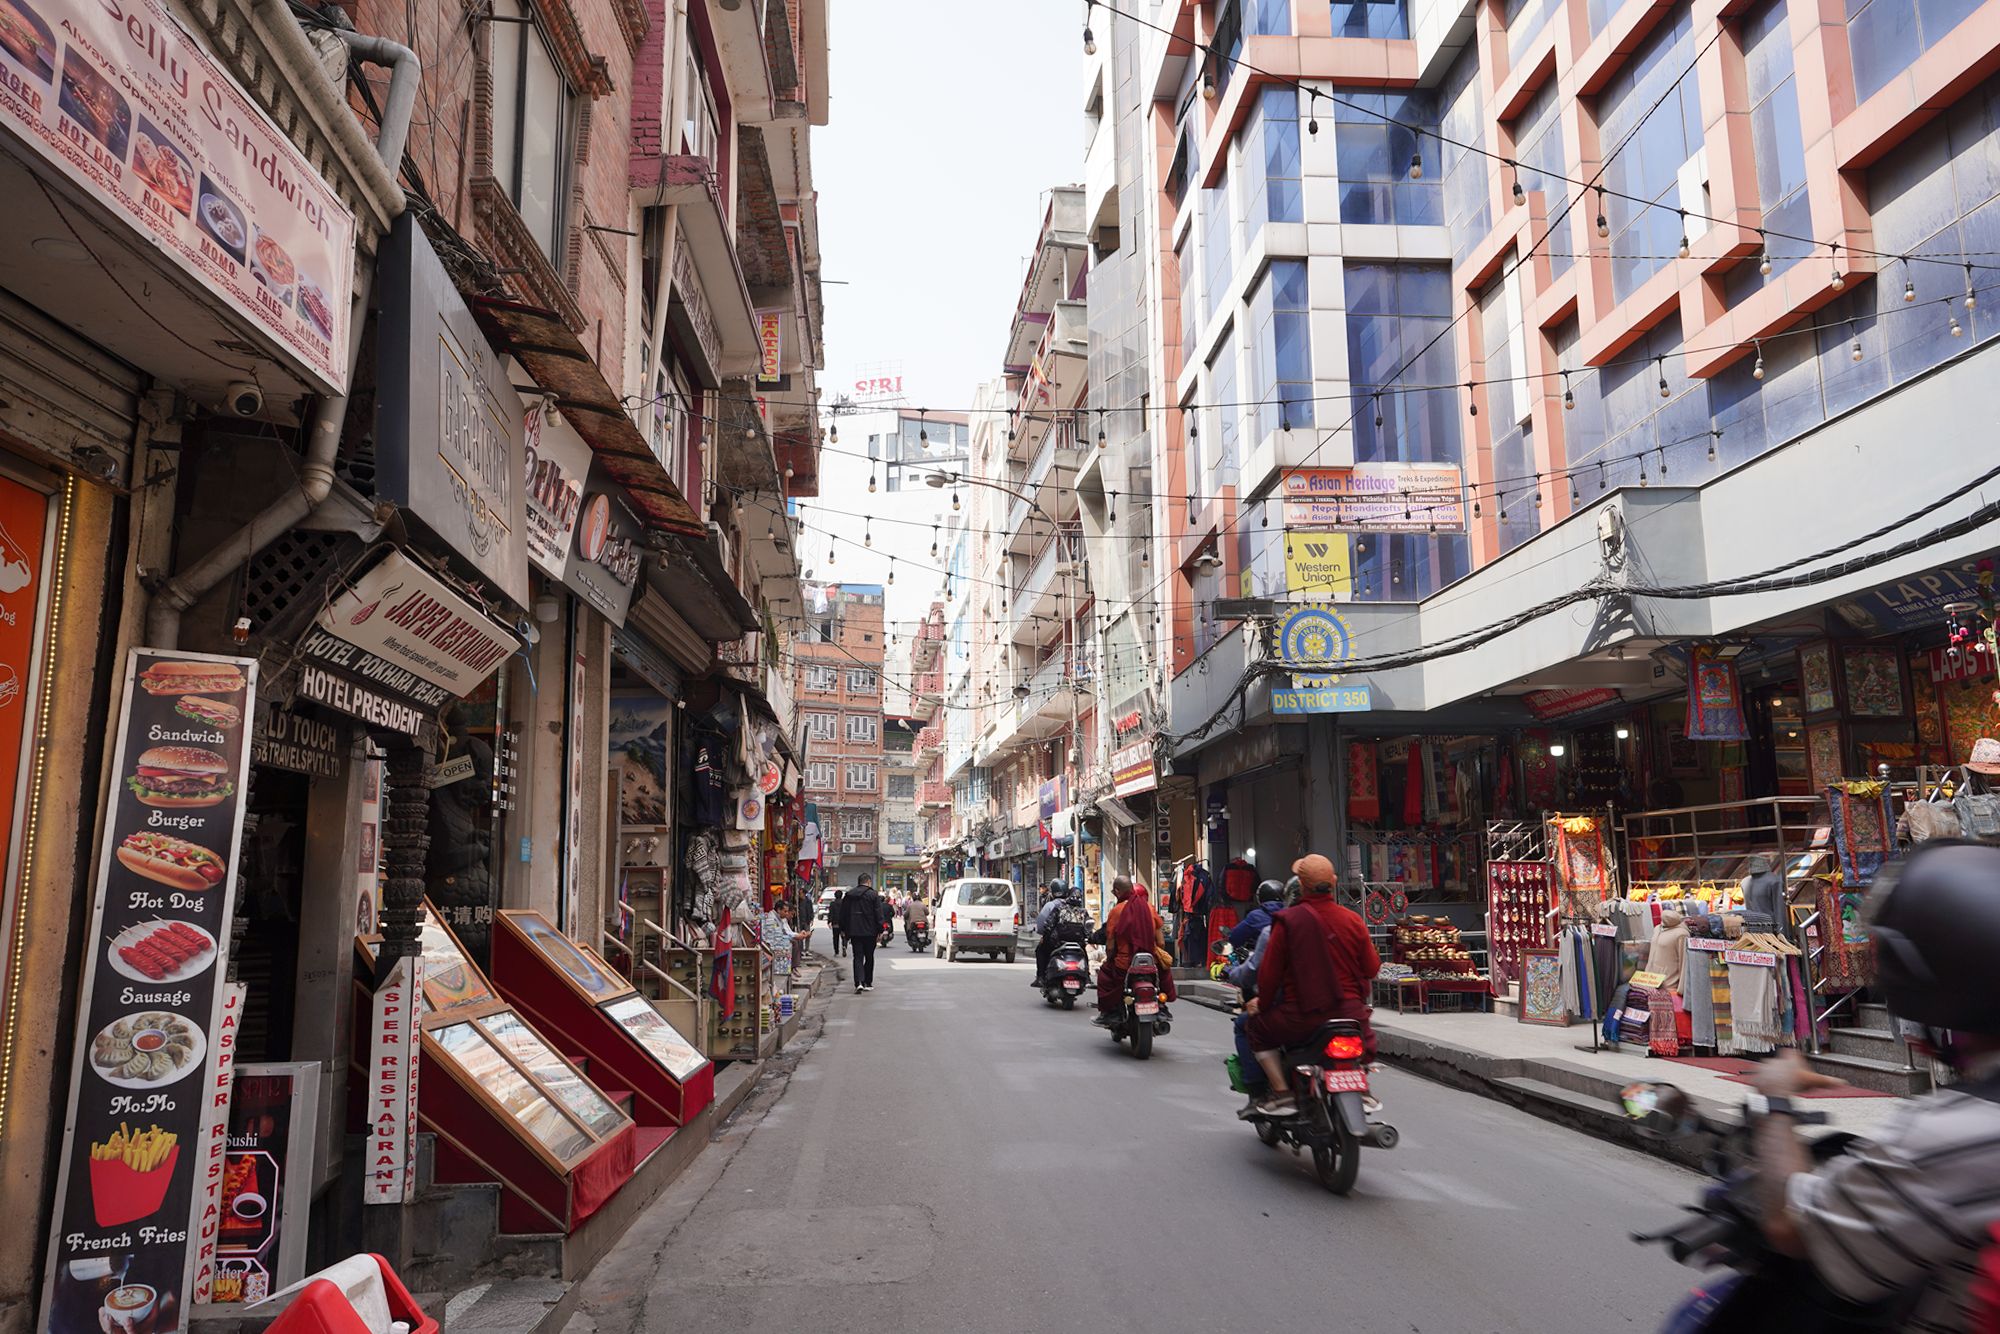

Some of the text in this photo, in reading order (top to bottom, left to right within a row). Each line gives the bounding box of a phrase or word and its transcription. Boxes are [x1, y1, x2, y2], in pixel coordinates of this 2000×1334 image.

[61, 18, 256, 215] Always Open, Always Delicious
[101, 0, 331, 241] elly Sandwich
[144, 81, 170, 115] HOUR
[170, 108, 205, 147] SERVICE
[58, 114, 122, 181] HOT DOG
[142, 188, 176, 227] ROLL
[255, 285, 284, 320] FRIES
[294, 319, 331, 360] SAUSAGE
[855, 375, 902, 394] SIRI
[1309, 475, 1341, 492] Asian
[1345, 474, 1396, 492] Heritage
[1419, 475, 1455, 483] Expeditions
[1312, 504, 1340, 513] Nepal
[1336, 514, 1367, 523] eritage
[1436, 514, 1458, 522] Cargo
[1295, 562, 1341, 573] Western
[1301, 573, 1335, 583] Union
[384, 589, 509, 674] JASPER RESTAURANT
[1301, 625, 1329, 637] INNER
[305, 631, 450, 708] HOTEL POKHARA PEACE
[1928, 643, 1978, 683] LAPIS
[303, 666, 424, 736] HOTEL PRESIDENT
[1273, 691, 1368, 709] DISTRICT 350
[148, 724, 225, 745] Sandwich
[265, 708, 337, 753] LD TOUCH
[443, 761, 472, 778] OPEN
[147, 809, 205, 831] Burger
[128, 891, 205, 913] Hot Dog
[119, 987, 192, 1007] Sausage
[213, 994, 237, 1108] JASPER
[405, 965, 422, 1193] JASPER RESTAURANT
[109, 1094, 176, 1116] Mo:Mo
[375, 1055, 399, 1195] RESTAURANT
[225, 1132, 258, 1148] Sushi
[66, 1226, 187, 1251] French Fries
